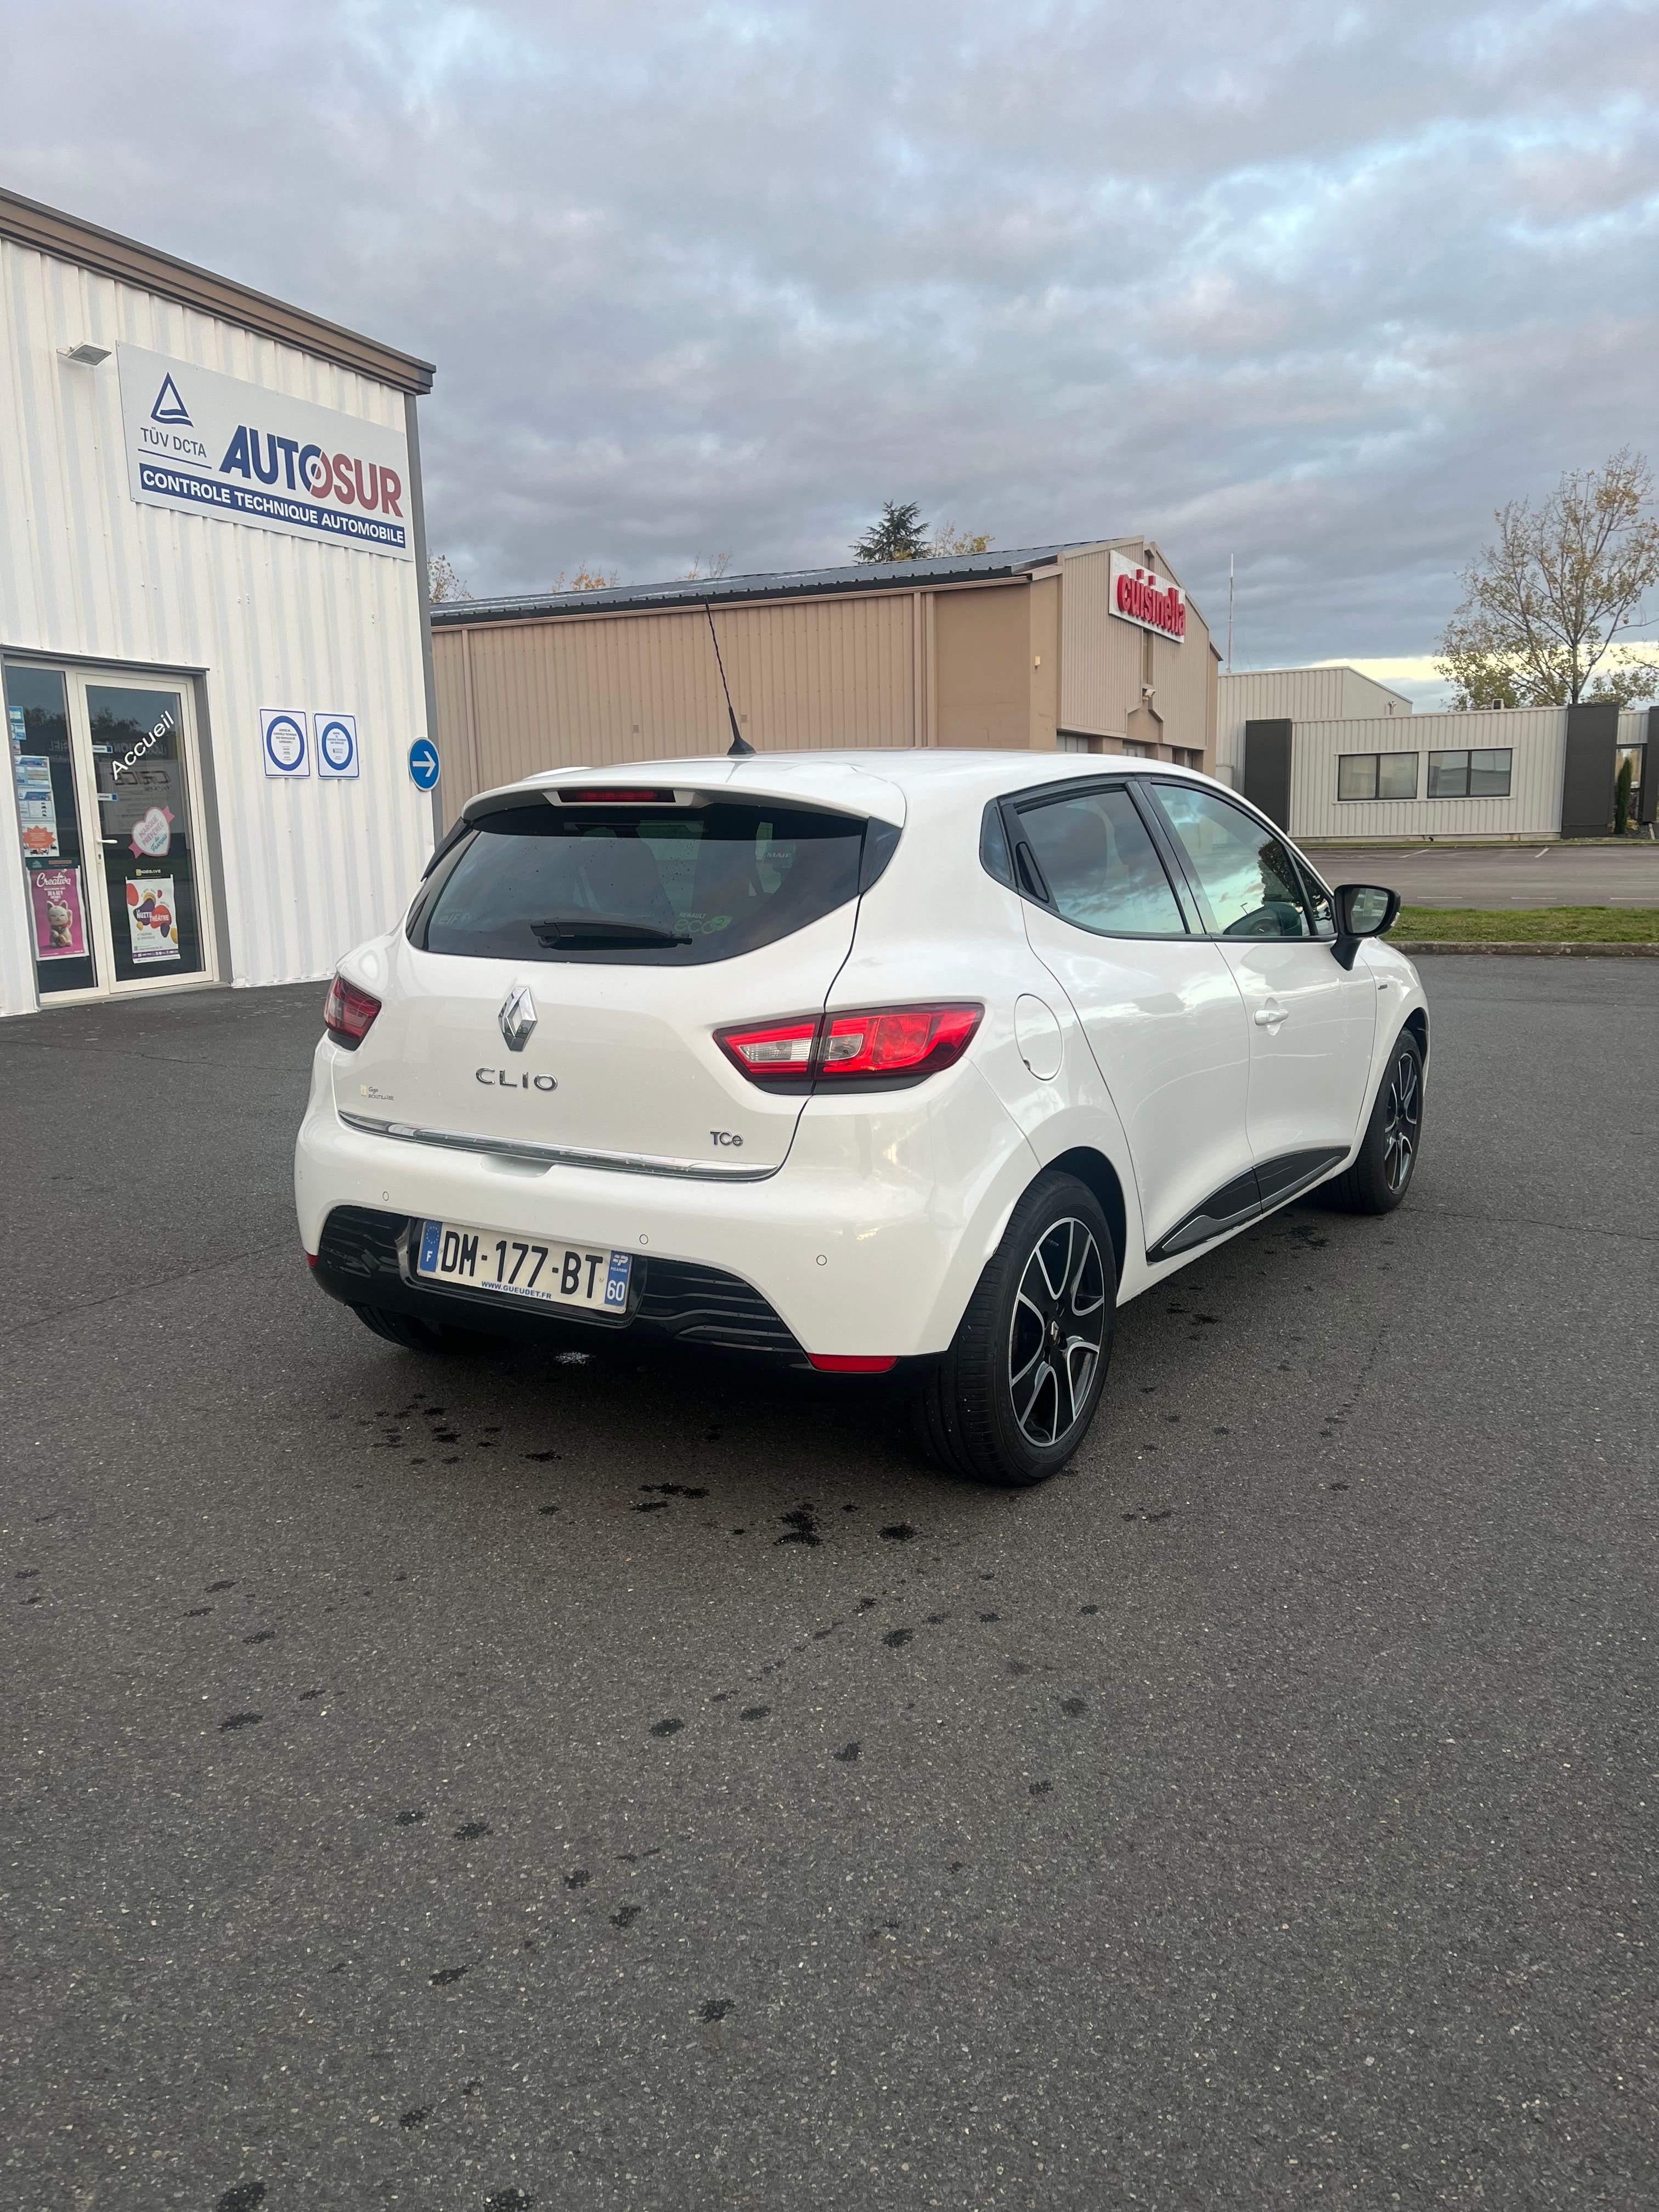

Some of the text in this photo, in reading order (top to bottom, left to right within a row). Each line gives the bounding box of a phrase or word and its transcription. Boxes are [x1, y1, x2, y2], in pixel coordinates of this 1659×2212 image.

[140, 426, 207, 459] TÜV DCTA
[219, 425, 404, 518] AUTOSUR
[143, 470, 404, 544] CONTROLE TECHNIQUE AUTOMOBILE
[1117, 568, 1186, 636] cuisinella
[112, 710, 174, 781] Accueil
[36, 872, 71, 887] Creativa
[476, 1066, 558, 1092] CLIO
[710, 1130, 743, 1147] TCe
[426, 1250, 433, 1262] F
[441, 1231, 603, 1299] DM-177-BT
[481, 1280, 552, 1299] WWW.GUEUDET.FR
[607, 1279, 625, 1301] 60
